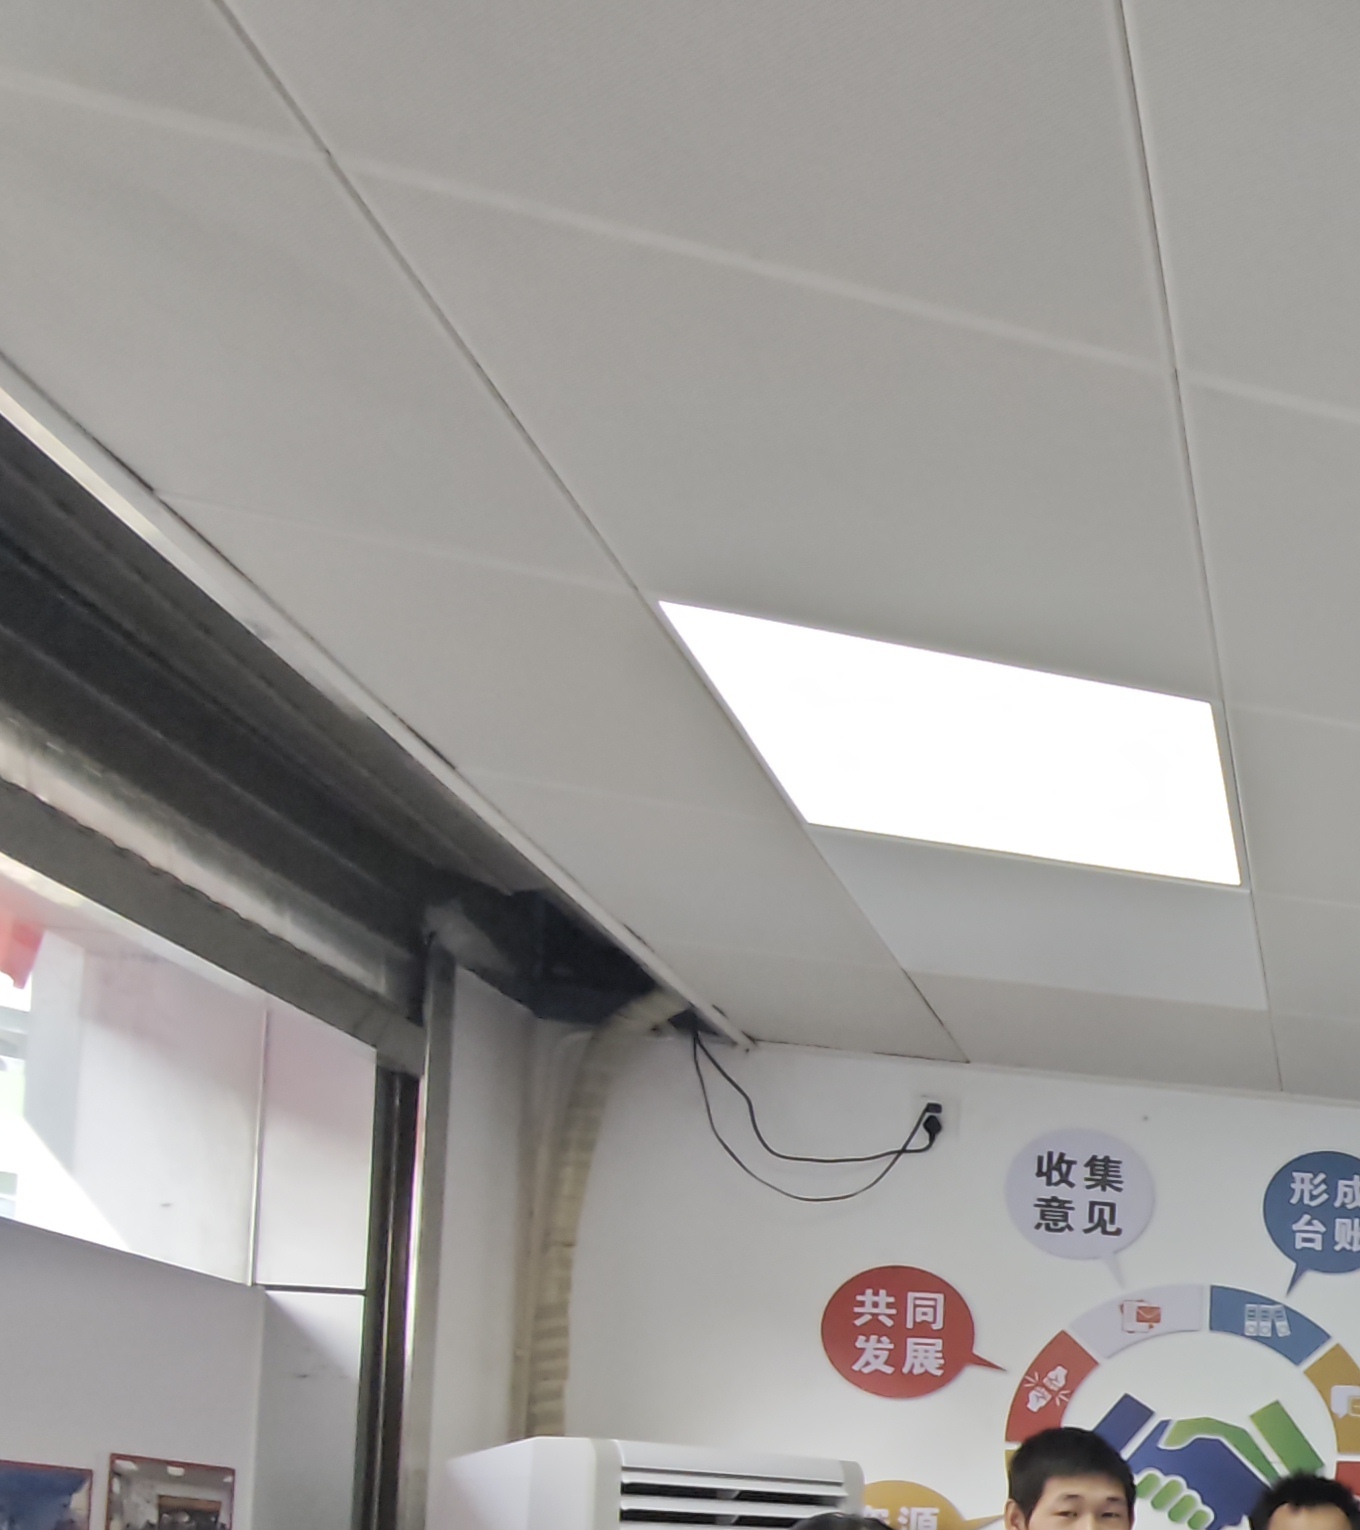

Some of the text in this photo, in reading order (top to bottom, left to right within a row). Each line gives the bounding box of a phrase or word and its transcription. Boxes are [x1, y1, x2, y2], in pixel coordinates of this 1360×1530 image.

[1034, 1150, 1124, 1193] 收集
[1033, 1195, 1123, 1237] 意见
[852, 1288, 945, 1331] 共同
[851, 1334, 945, 1377] 发展
